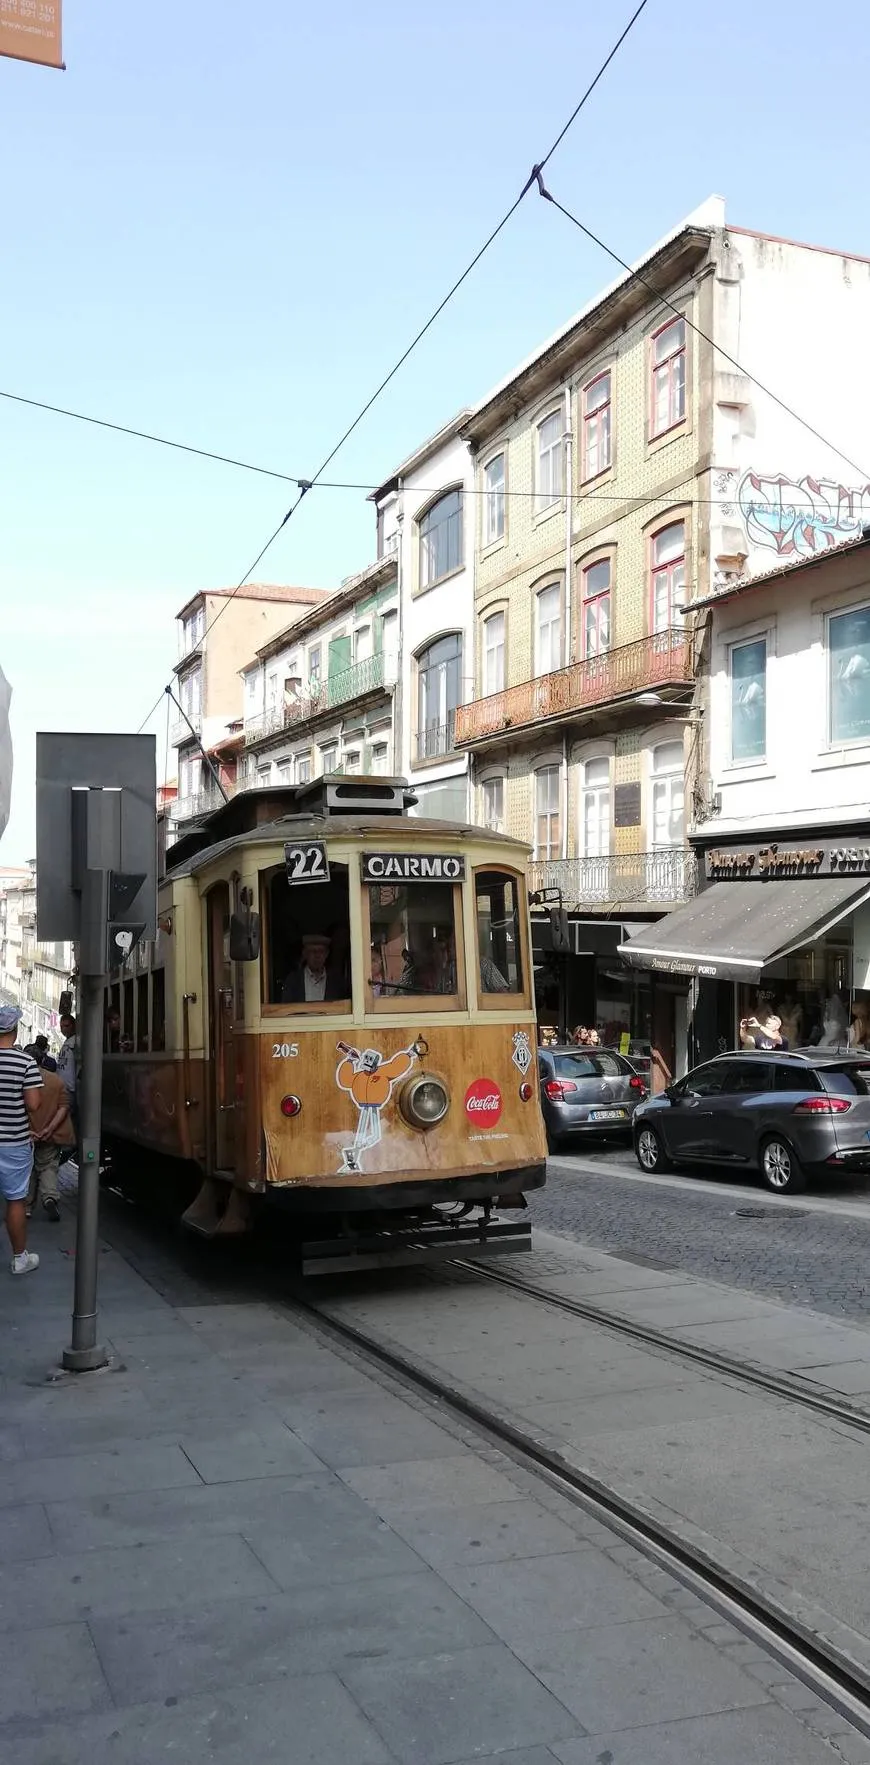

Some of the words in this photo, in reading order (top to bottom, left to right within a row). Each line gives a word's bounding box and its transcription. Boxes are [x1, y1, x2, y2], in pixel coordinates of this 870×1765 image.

[288, 848, 325, 878] 22
[367, 856, 461, 878] CARMO
[697, 965, 717, 976] PORTO
[272, 1043, 299, 1059] 205
